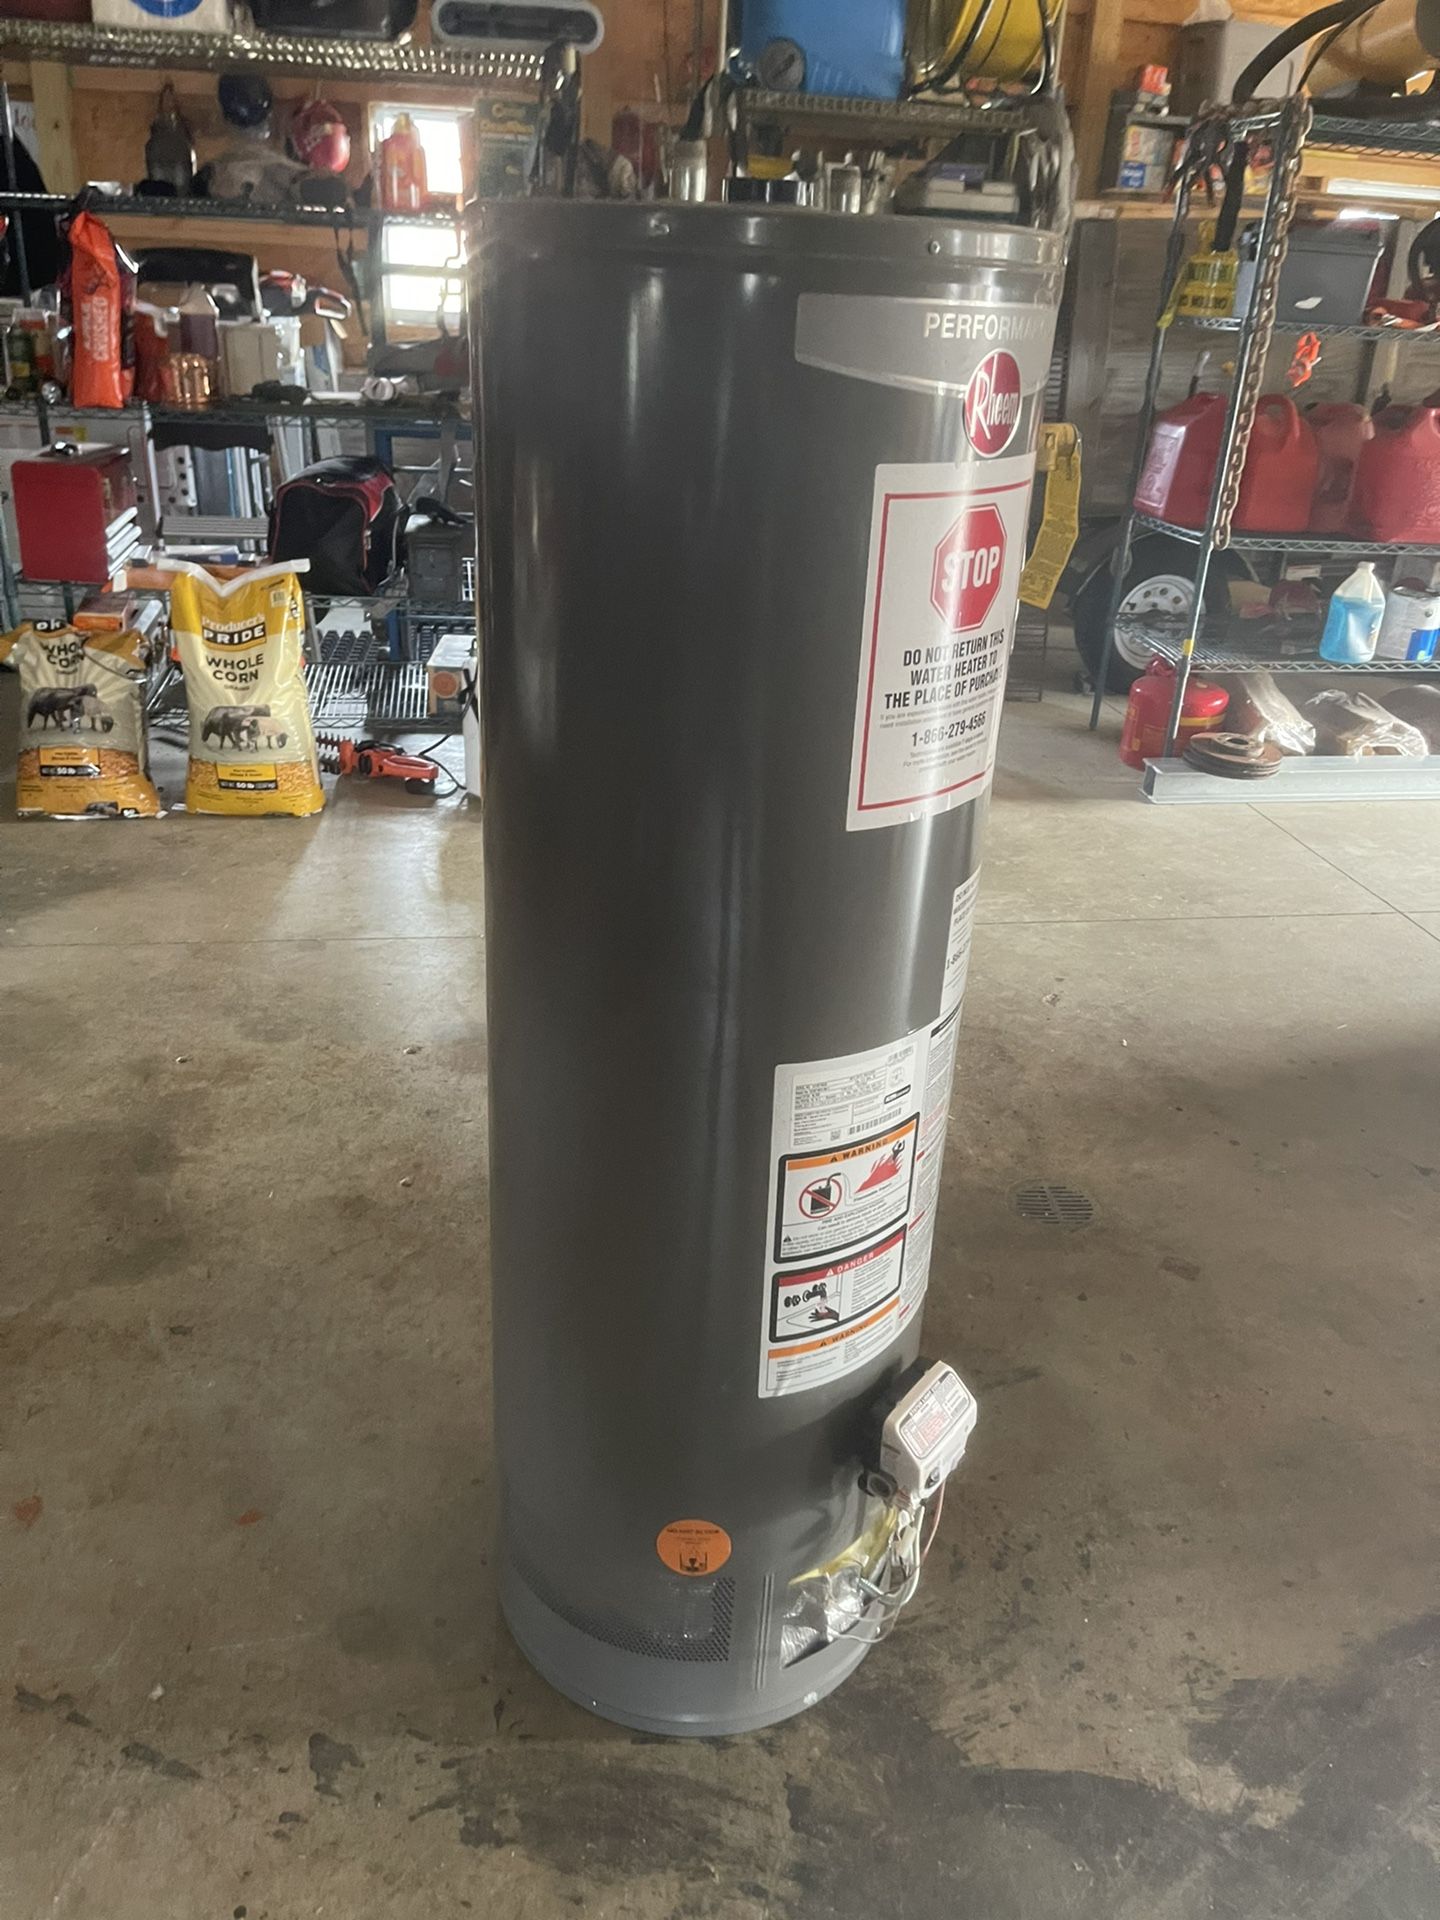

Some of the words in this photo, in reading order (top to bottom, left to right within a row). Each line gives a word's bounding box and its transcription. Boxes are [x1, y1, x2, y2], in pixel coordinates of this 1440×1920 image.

[92, 296, 109, 361] CRUSHED
[968, 352, 1019, 440] Rheem
[941, 545, 1000, 593] STOP
[203, 625, 265, 644] PRIDE
[903, 648, 922, 667] DO
[925, 645, 951, 664] NOT
[951, 635, 989, 659] RETURN
[989, 628, 1005, 648] THIS
[206, 652, 265, 671] WHOLE
[212, 669, 259, 684] CORN
[910, 665, 952, 686] WATER
[953, 654, 988, 679] HEATER
[884, 691, 911, 709] THE
[914, 684, 952, 705] PLACE
[954, 679, 967, 698] OF
[842, 1139, 888, 1160] WARNING
[836, 1251, 875, 1274] DANGER
